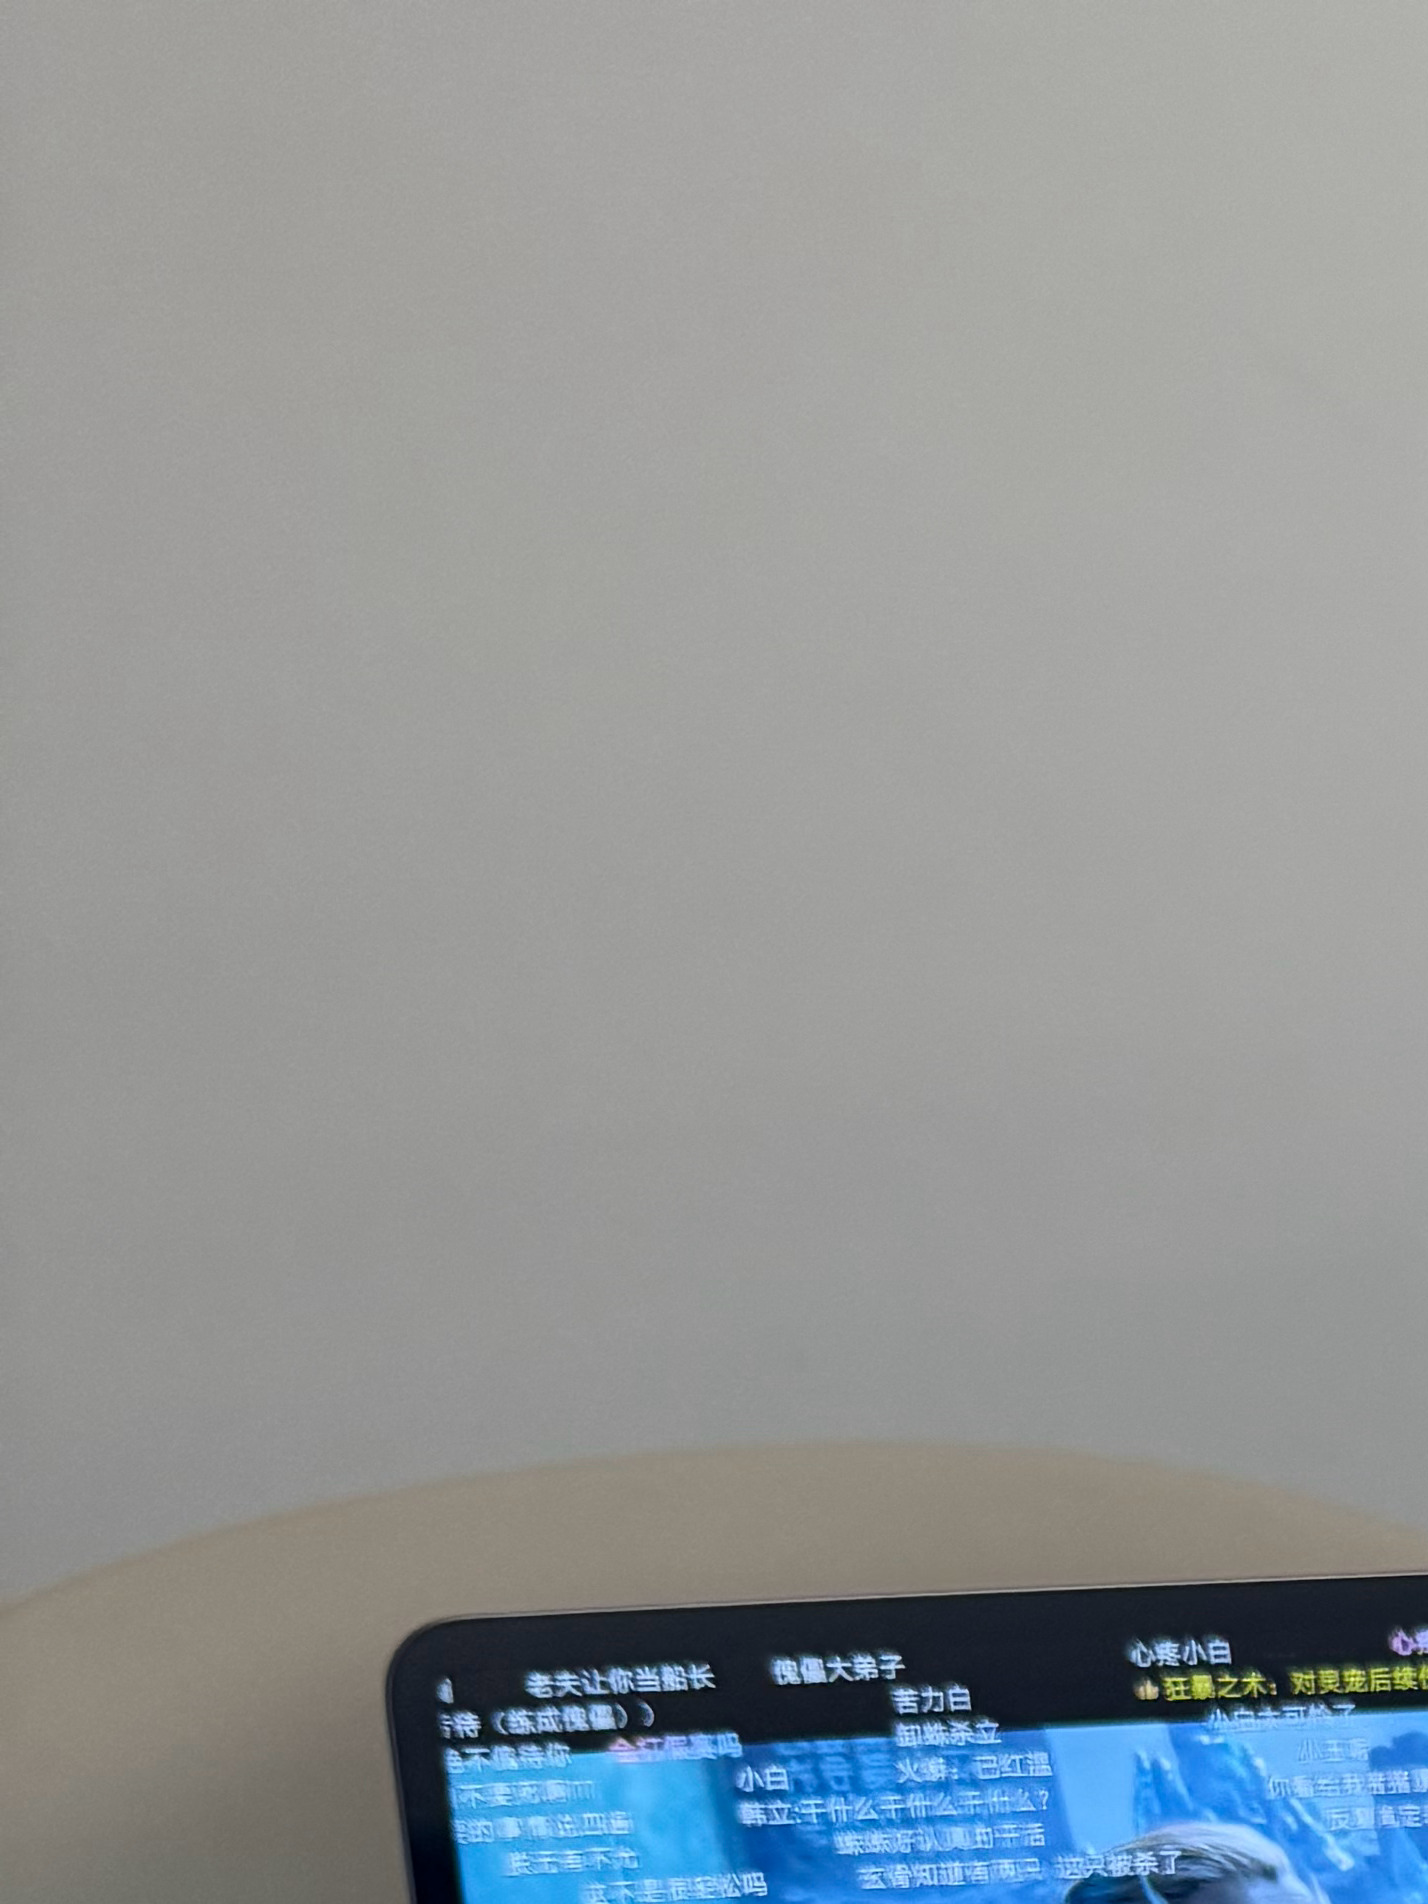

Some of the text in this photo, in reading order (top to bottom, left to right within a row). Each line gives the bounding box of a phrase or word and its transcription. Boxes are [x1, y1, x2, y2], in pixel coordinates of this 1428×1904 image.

[1128, 1637, 1232, 1668] 心疼小白
[892, 1685, 972, 1714] 苦力白
[735, 1765, 789, 1793] 小白
